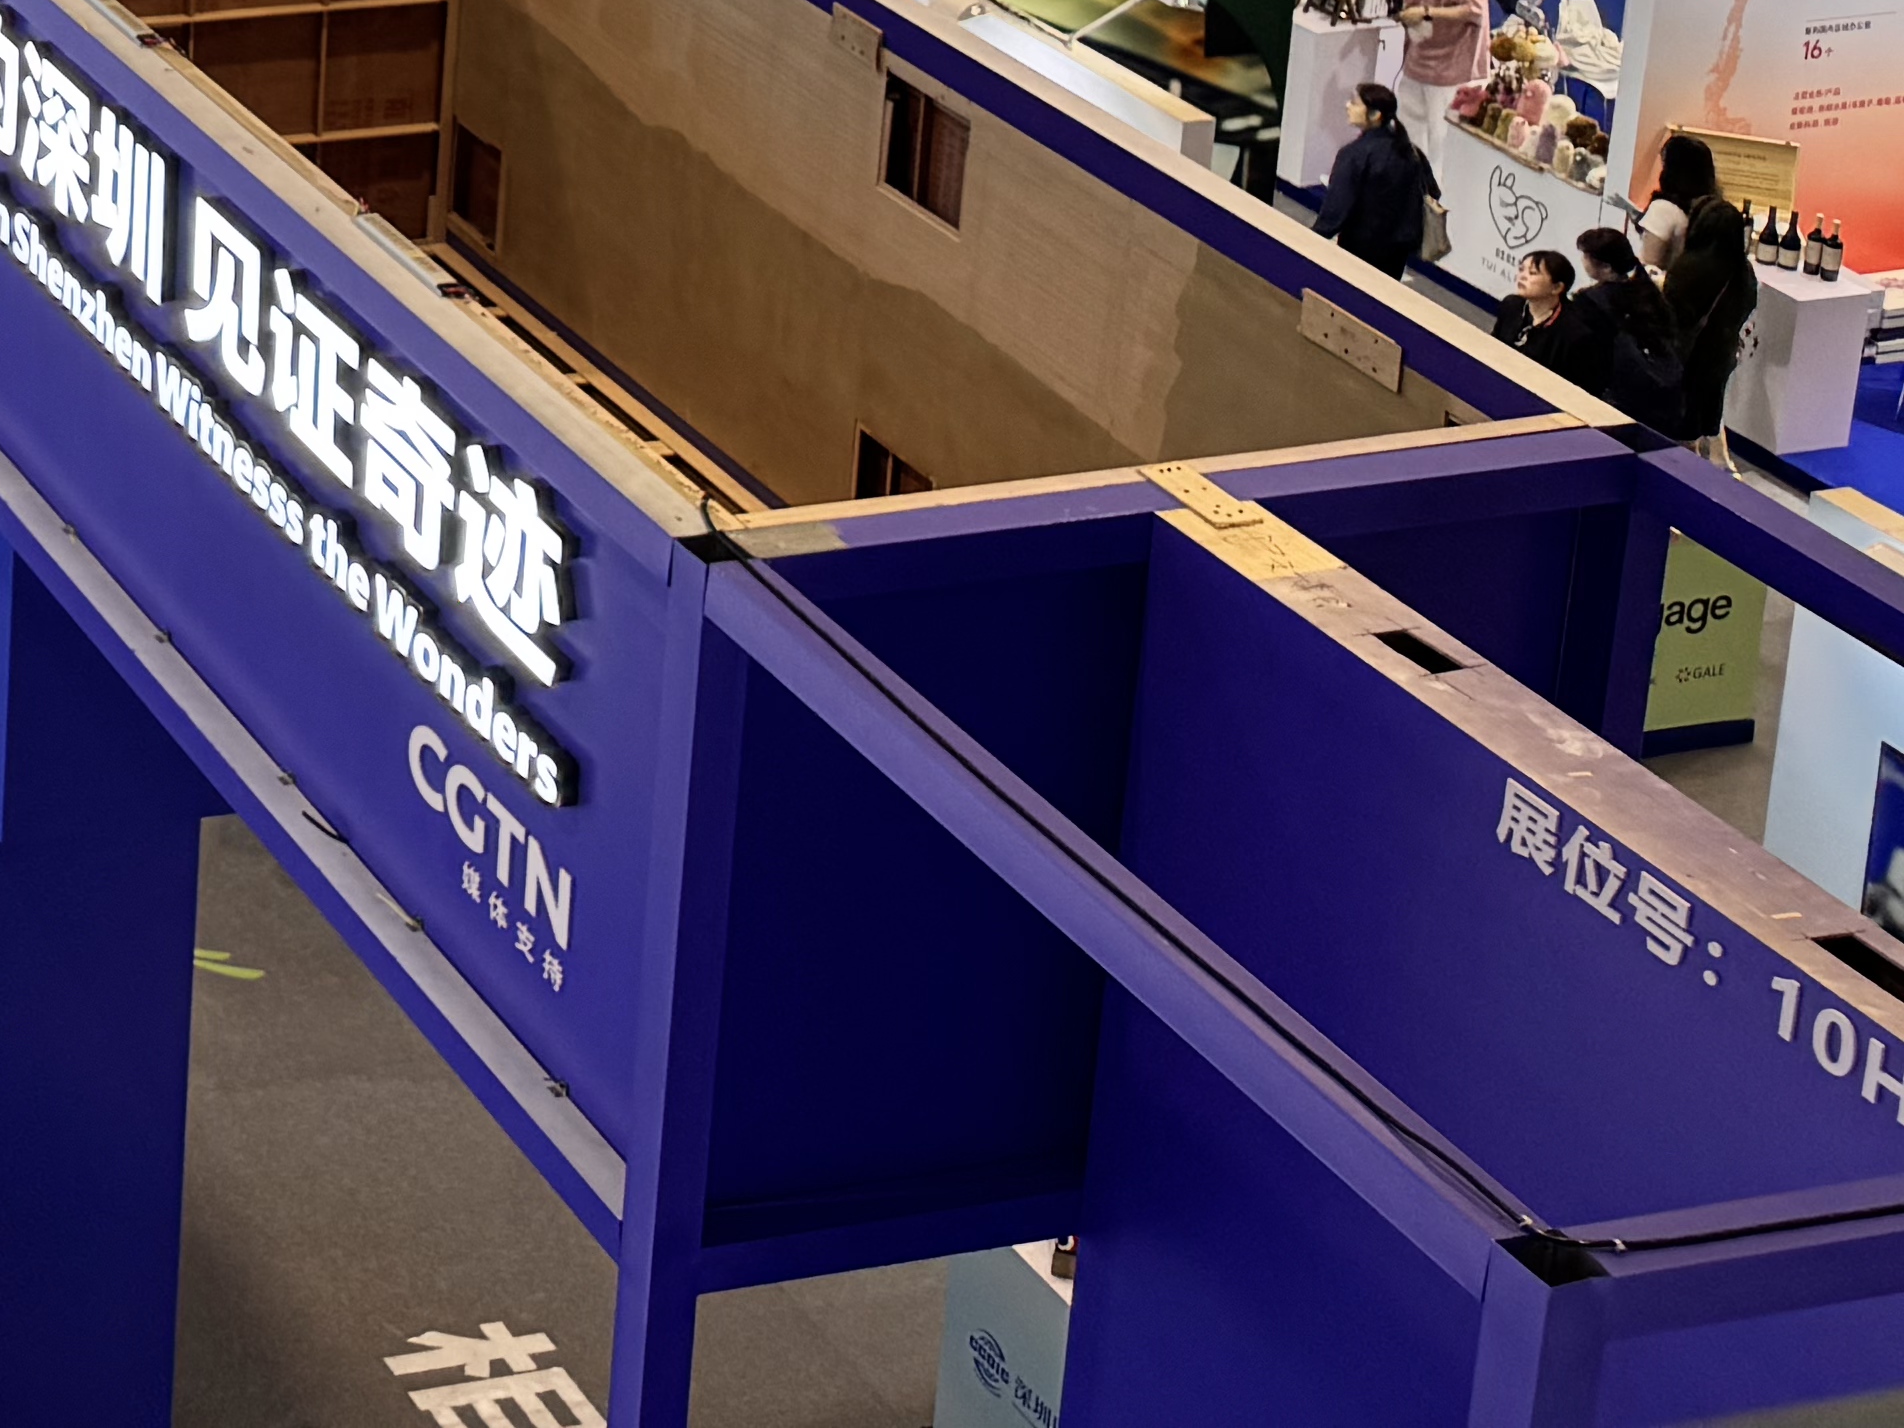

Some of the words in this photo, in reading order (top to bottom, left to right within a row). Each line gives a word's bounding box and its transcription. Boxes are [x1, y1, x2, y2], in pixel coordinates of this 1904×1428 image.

[1803, 39, 1822, 60] 16
[12, 212, 153, 393] Shenzhen
[308, 513, 371, 613] the
[374, 572, 558, 805] Wonders
[184, 196, 563, 687] 见证奇迹
[1661, 595, 1733, 634] age
[1692, 662, 1727, 680] GALE
[408, 724, 572, 951] CGTN
[462, 860, 563, 992] 媒体支持
[1495, 776, 1724, 988] 展位号：
[1770, 976, 1904, 1127] 10H
